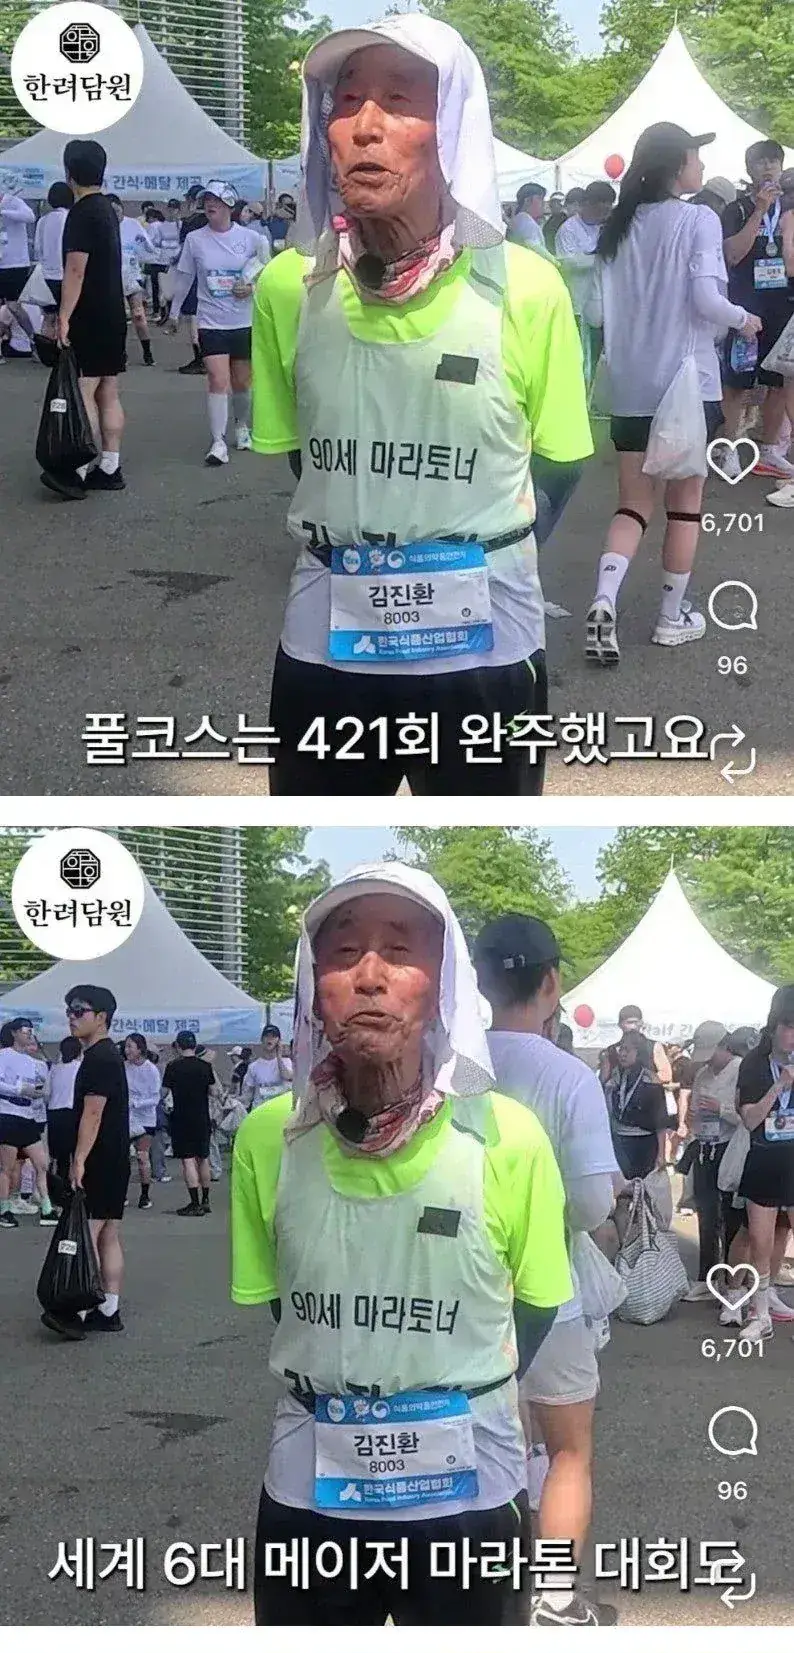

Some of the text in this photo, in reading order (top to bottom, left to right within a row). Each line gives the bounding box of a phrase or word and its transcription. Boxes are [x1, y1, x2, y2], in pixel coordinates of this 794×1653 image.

[309, 438, 478, 484] 90세 마라토너
[368, 582, 435, 607] 김진환
[384, 611, 420, 625] 8003
[291, 1291, 460, 1335] 90세 마라토너
[353, 1431, 420, 1456] 김진환
[368, 1459, 405, 1474] 8003
